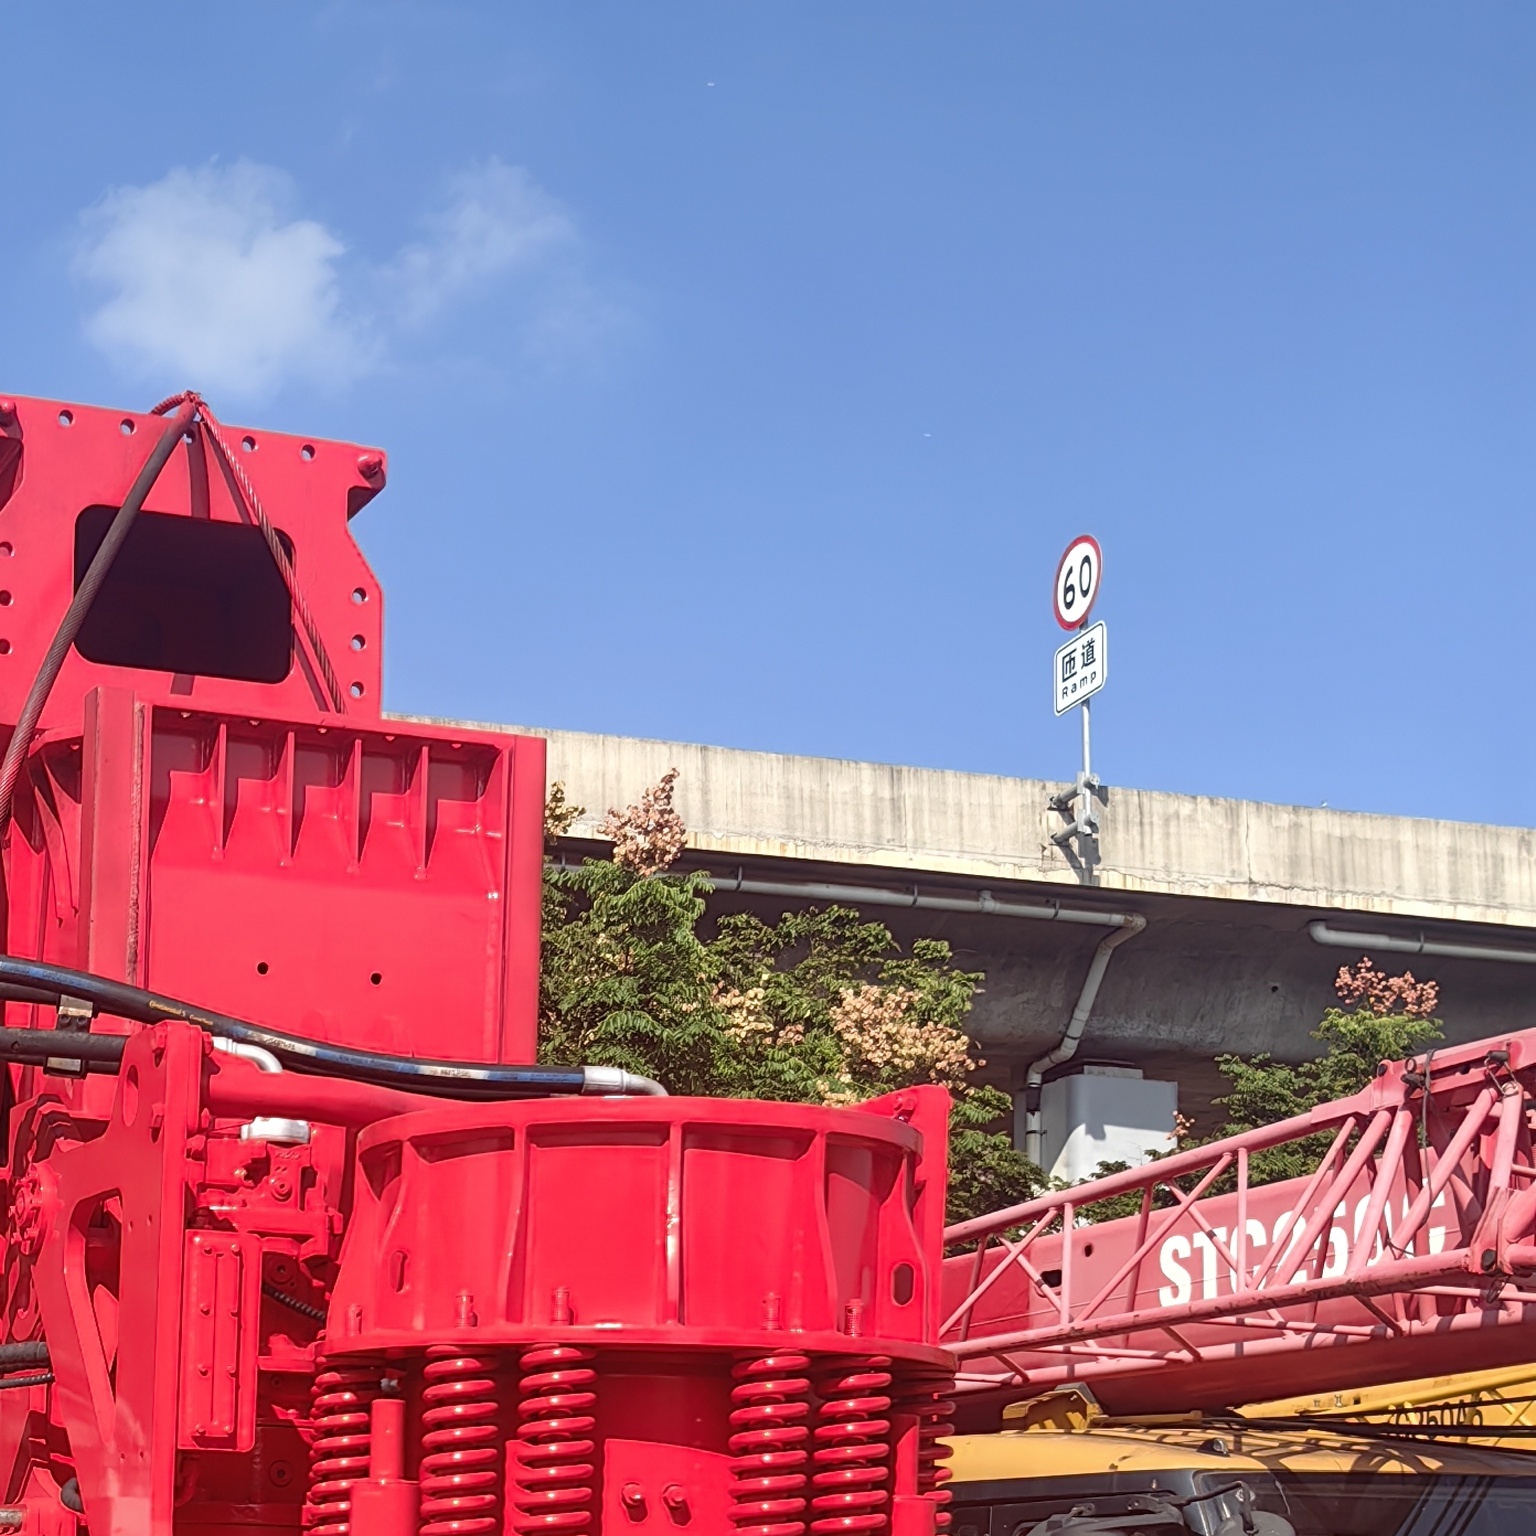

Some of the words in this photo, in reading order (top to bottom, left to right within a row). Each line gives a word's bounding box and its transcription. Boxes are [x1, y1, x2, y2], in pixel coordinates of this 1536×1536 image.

[1064, 555, 1091, 610] 60
[1062, 638, 1096, 683] 匝道
[1061, 671, 1096, 700] Ramp
